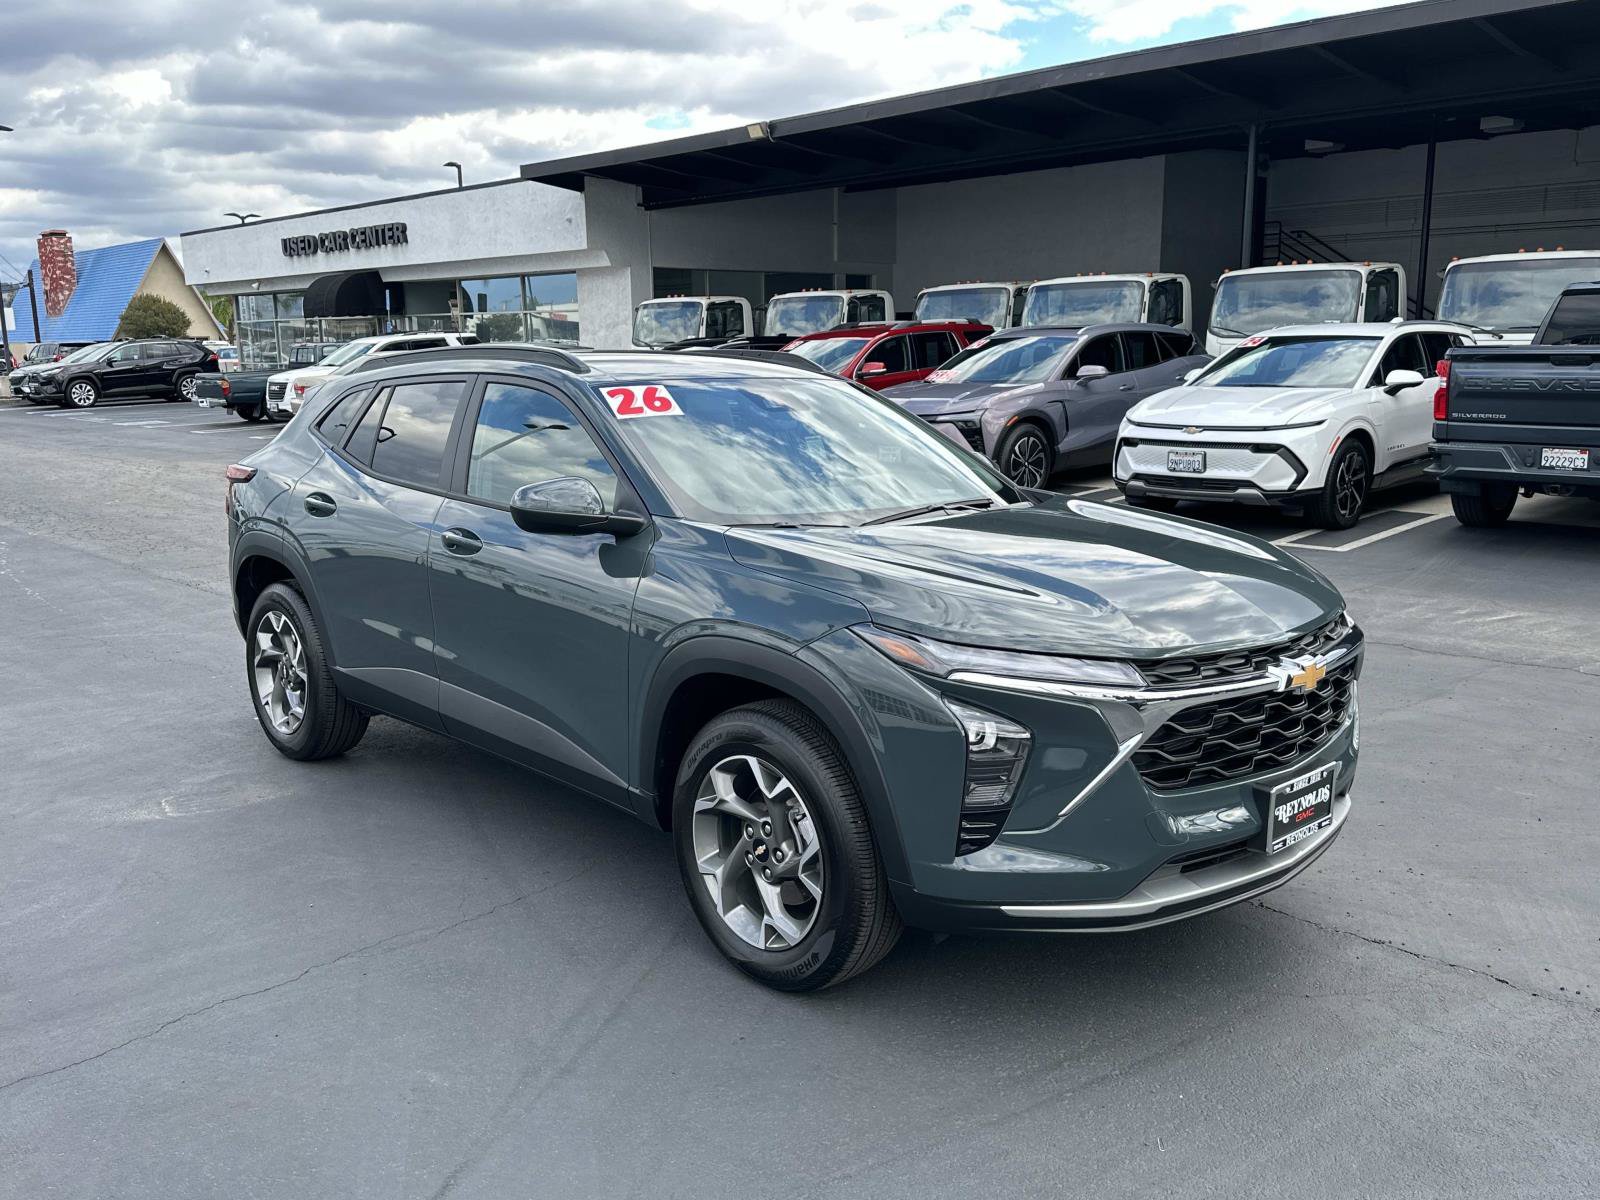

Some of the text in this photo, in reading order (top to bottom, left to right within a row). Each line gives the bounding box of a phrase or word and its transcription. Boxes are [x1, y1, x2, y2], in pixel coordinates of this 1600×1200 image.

[281, 222, 408, 257] USED CAR CENTER
[606, 386, 673, 415] 26
[1543, 454, 1587, 468] 92229C3
[1275, 785, 1330, 823] REYNOLDS
[1296, 807, 1315, 822] GMC
[1286, 823, 1319, 846] REYNOLDS
